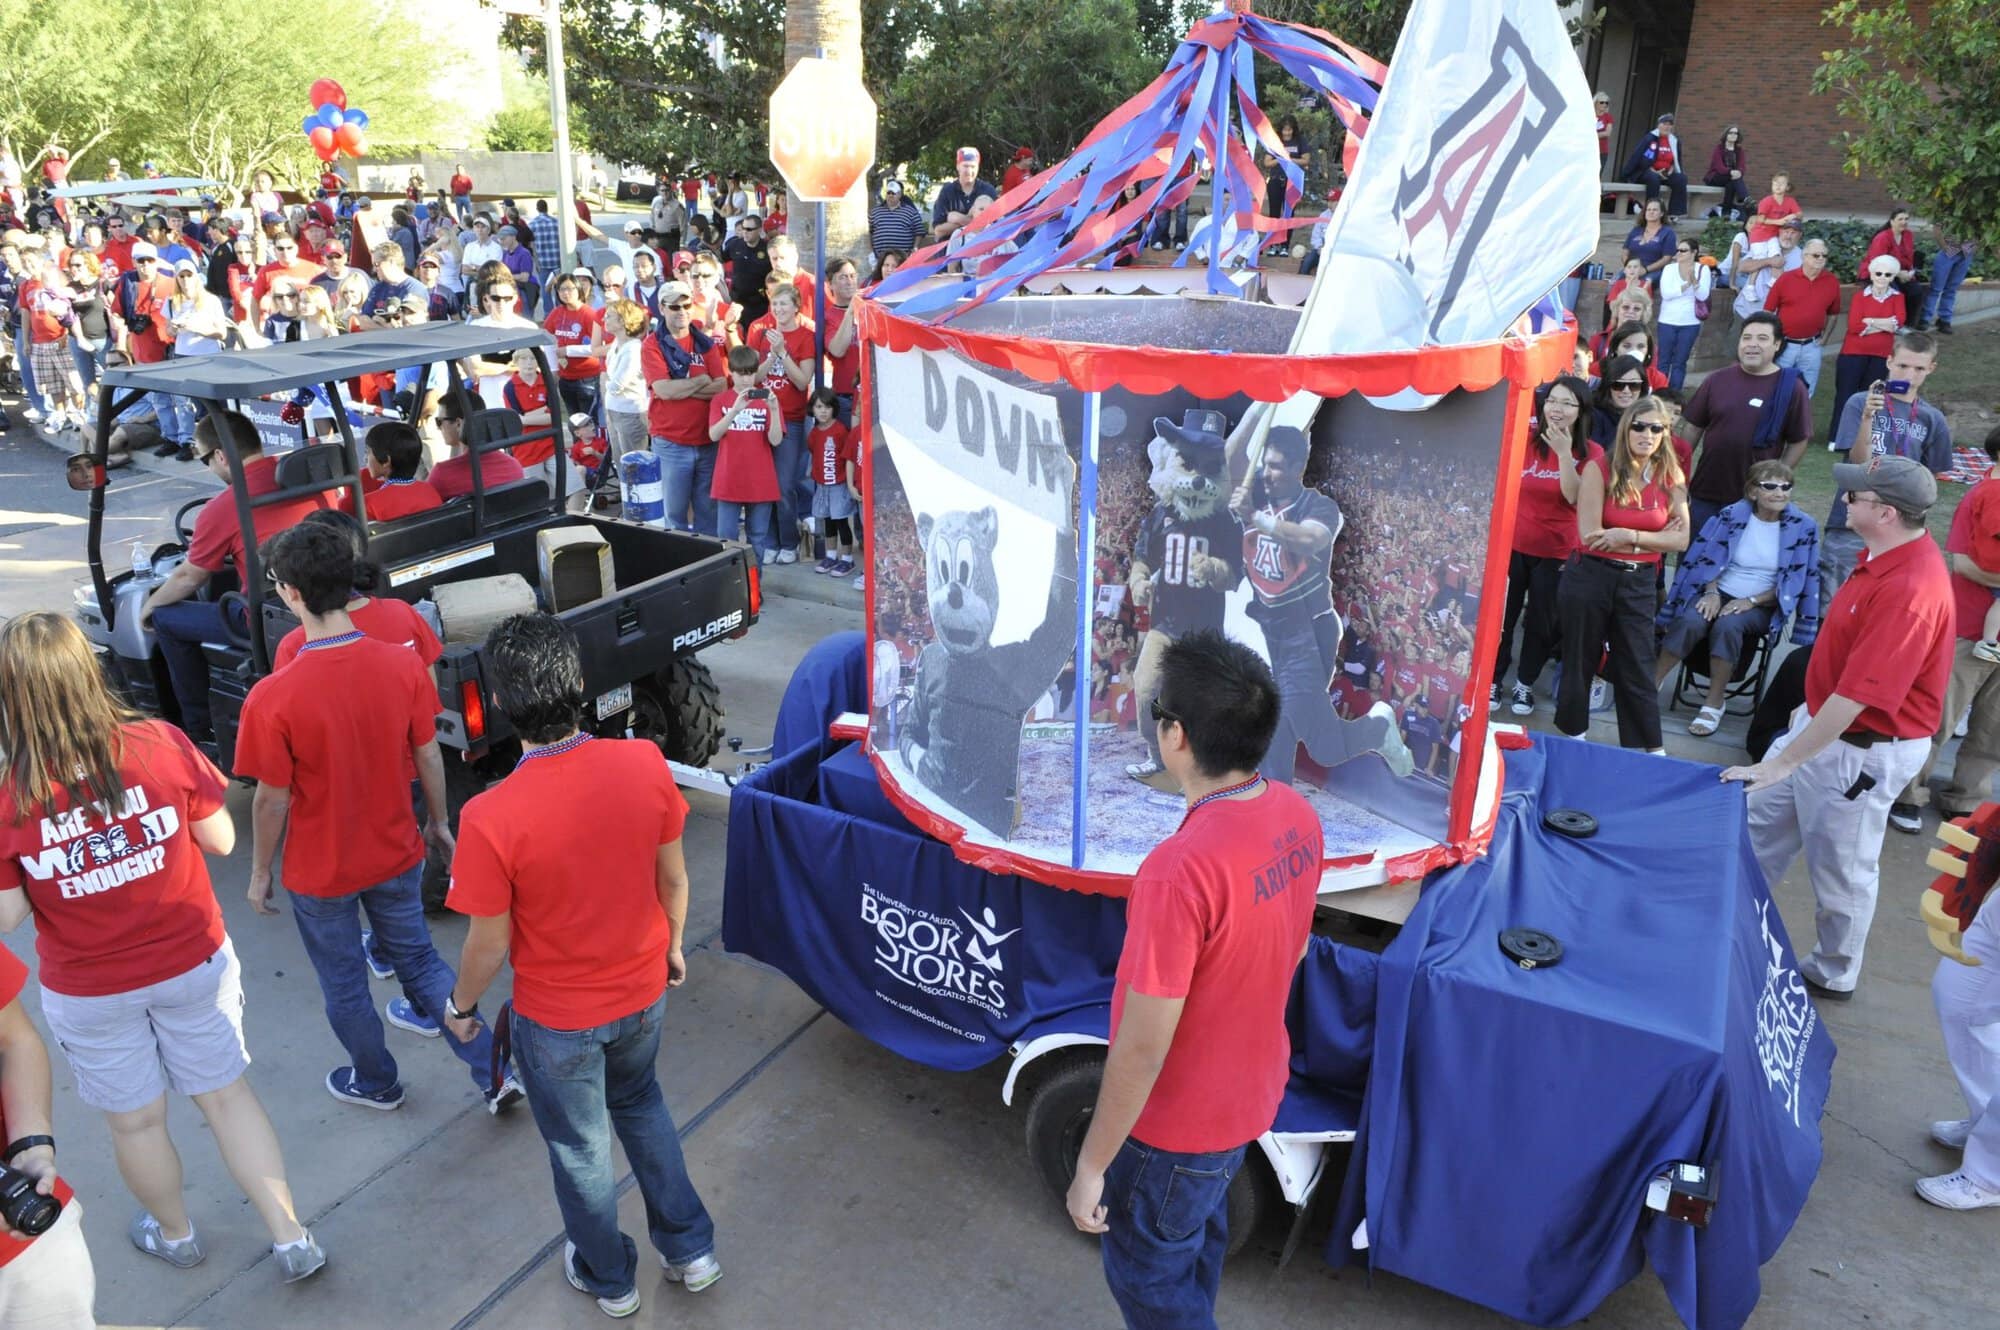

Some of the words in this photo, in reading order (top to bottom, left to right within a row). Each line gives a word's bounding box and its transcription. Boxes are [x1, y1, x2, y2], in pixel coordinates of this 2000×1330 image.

[778, 108, 867, 159] STOP
[921, 350, 1062, 494] DOWN
[672, 609, 743, 652] POLARIS
[20, 805, 180, 880] WD
[40, 805, 93, 847] ARE
[57, 844, 166, 899] ENOUGH?
[863, 883, 876, 897] THE
[876, 890, 917, 917] UNIVERSITY
[861, 893, 962, 961] BOOK
[875, 919, 1006, 1010] STORES
[875, 990, 986, 1043] www.uofabookstores.com
[917, 983, 966, 1001] ASSOCIATED
[967, 995, 1002, 1020] STUDENTS
